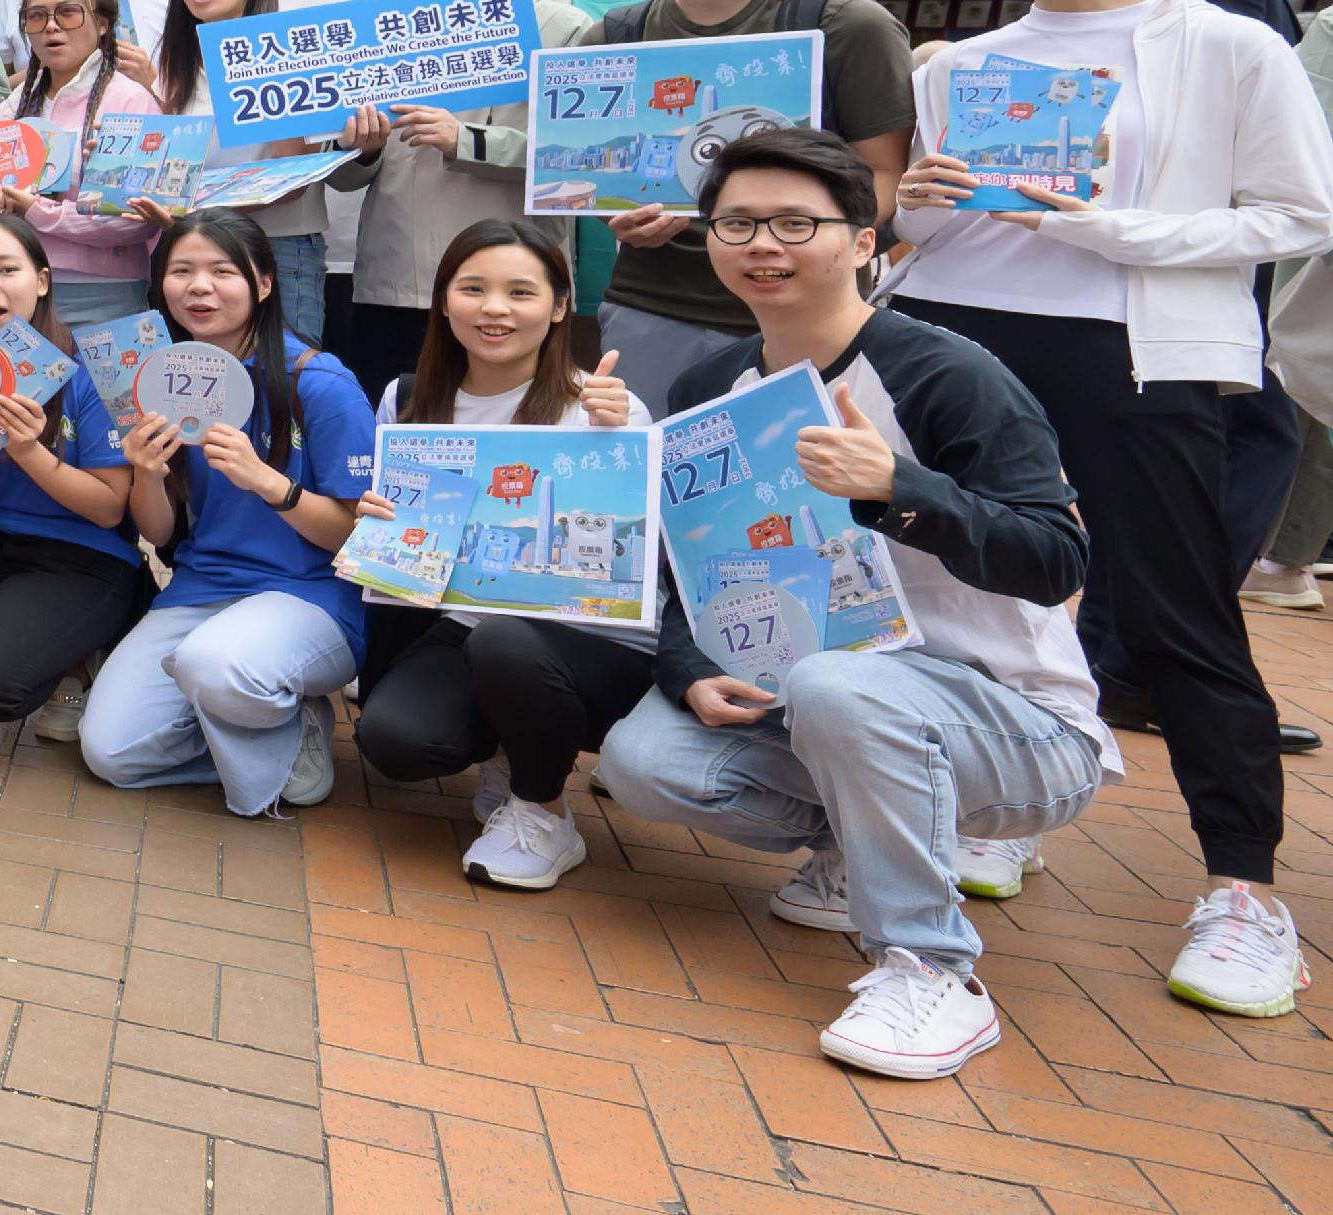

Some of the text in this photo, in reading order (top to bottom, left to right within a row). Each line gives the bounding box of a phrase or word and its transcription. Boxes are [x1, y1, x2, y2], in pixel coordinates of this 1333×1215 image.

[223, 23, 353, 66] 投入選舉
[228, 26, 516, 80] Join the Election Together We Create the Future
[233, 45, 520, 122] 2025 立法會換屆選舉
[345, 71, 524, 106] Legislative Council General Election
[546, 75, 578, 85] 2025
[974, 173, 1077, 192] 定你到時見
[718, 612, 741, 625] 2025
